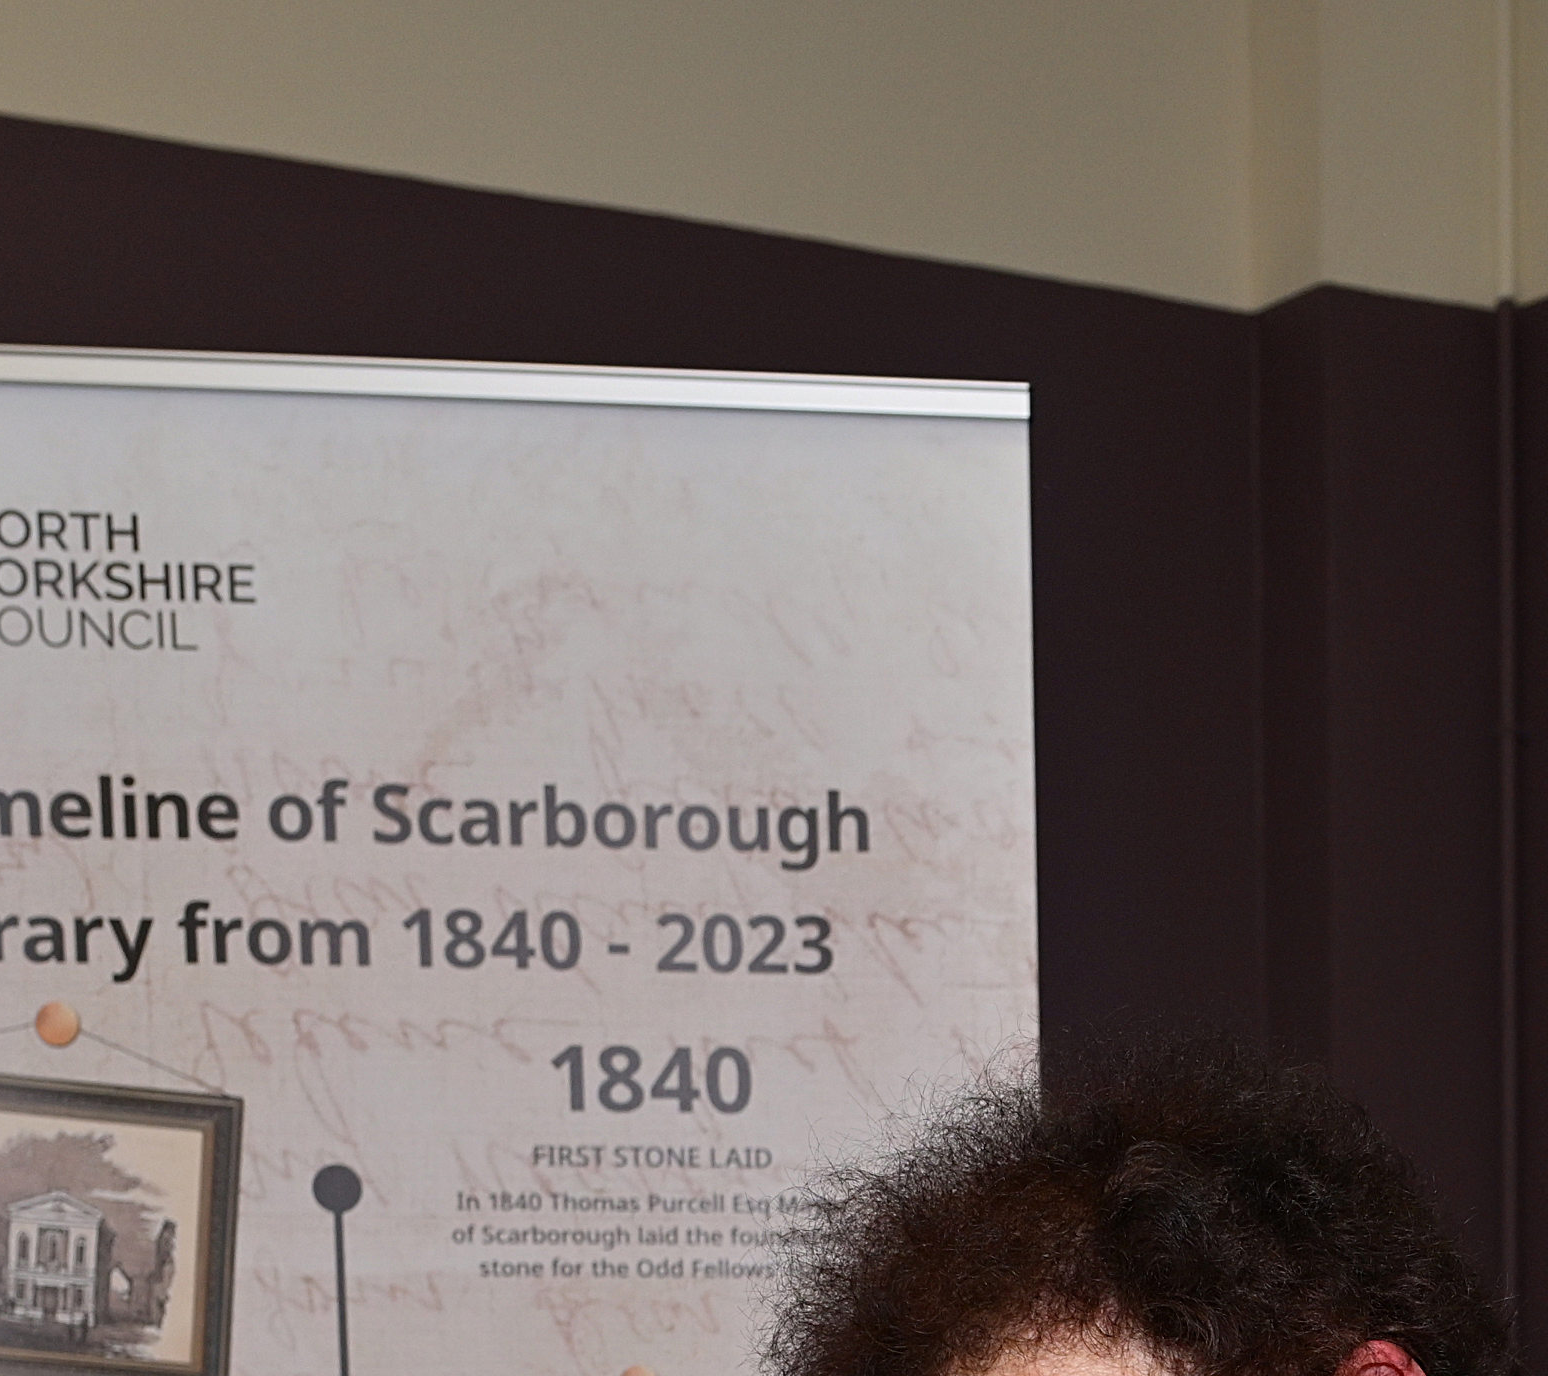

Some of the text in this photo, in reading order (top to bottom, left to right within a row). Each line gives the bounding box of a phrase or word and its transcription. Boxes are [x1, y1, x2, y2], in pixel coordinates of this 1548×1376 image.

[268, 779, 347, 842] of
[373, 783, 871, 872] Scarborough
[179, 903, 372, 967] from
[402, 909, 582, 971] 1840
[655, 914, 835, 975] 2023
[550, 1044, 753, 1114] 1840
[532, 1145, 773, 1170] FIRST STONE LAID
[456, 1191, 724, 1214] In 1840 Thomas Purcell
[451, 1225, 475, 1245] of
[482, 1226, 630, 1251] Scarborough
[638, 1226, 678, 1246] laid
[685, 1228, 723, 1247] the
[479, 1258, 683, 1279] stone for the Odd
